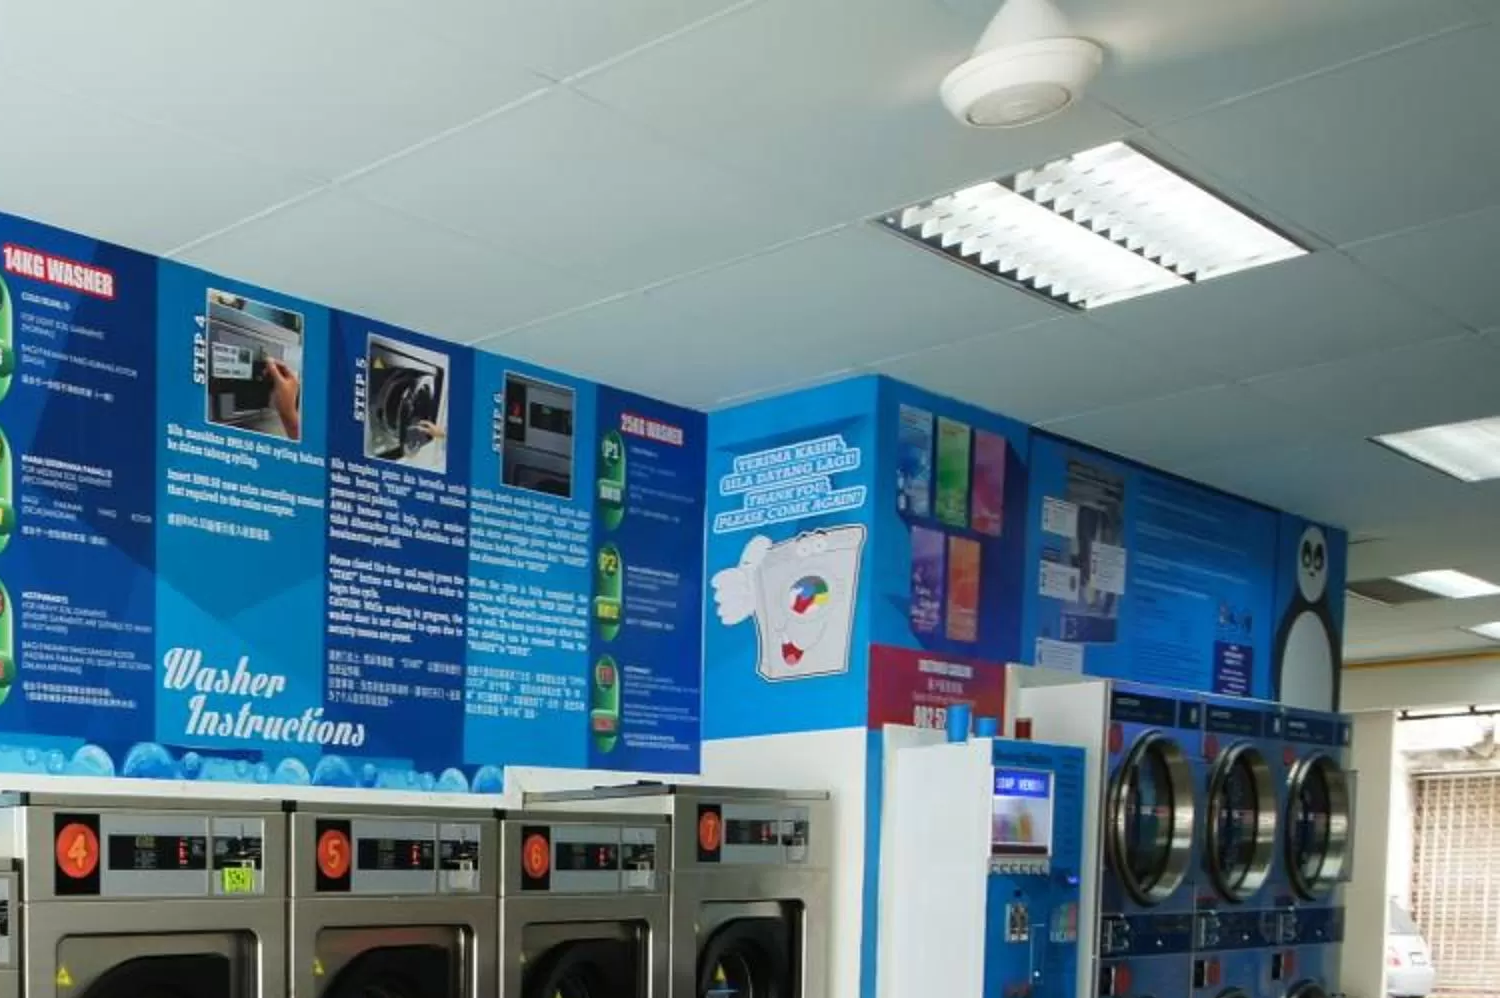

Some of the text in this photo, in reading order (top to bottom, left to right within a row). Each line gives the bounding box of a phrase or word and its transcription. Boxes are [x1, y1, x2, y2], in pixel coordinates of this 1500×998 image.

[4, 246, 113, 296] 14KG WASHER
[194, 316, 206, 384] STEP 4
[354, 357, 366, 422] STEP 5
[163, 647, 287, 699] Washer
[185, 695, 365, 747] Instructions
[68, 833, 88, 869] 4
[327, 839, 340, 868] 5
